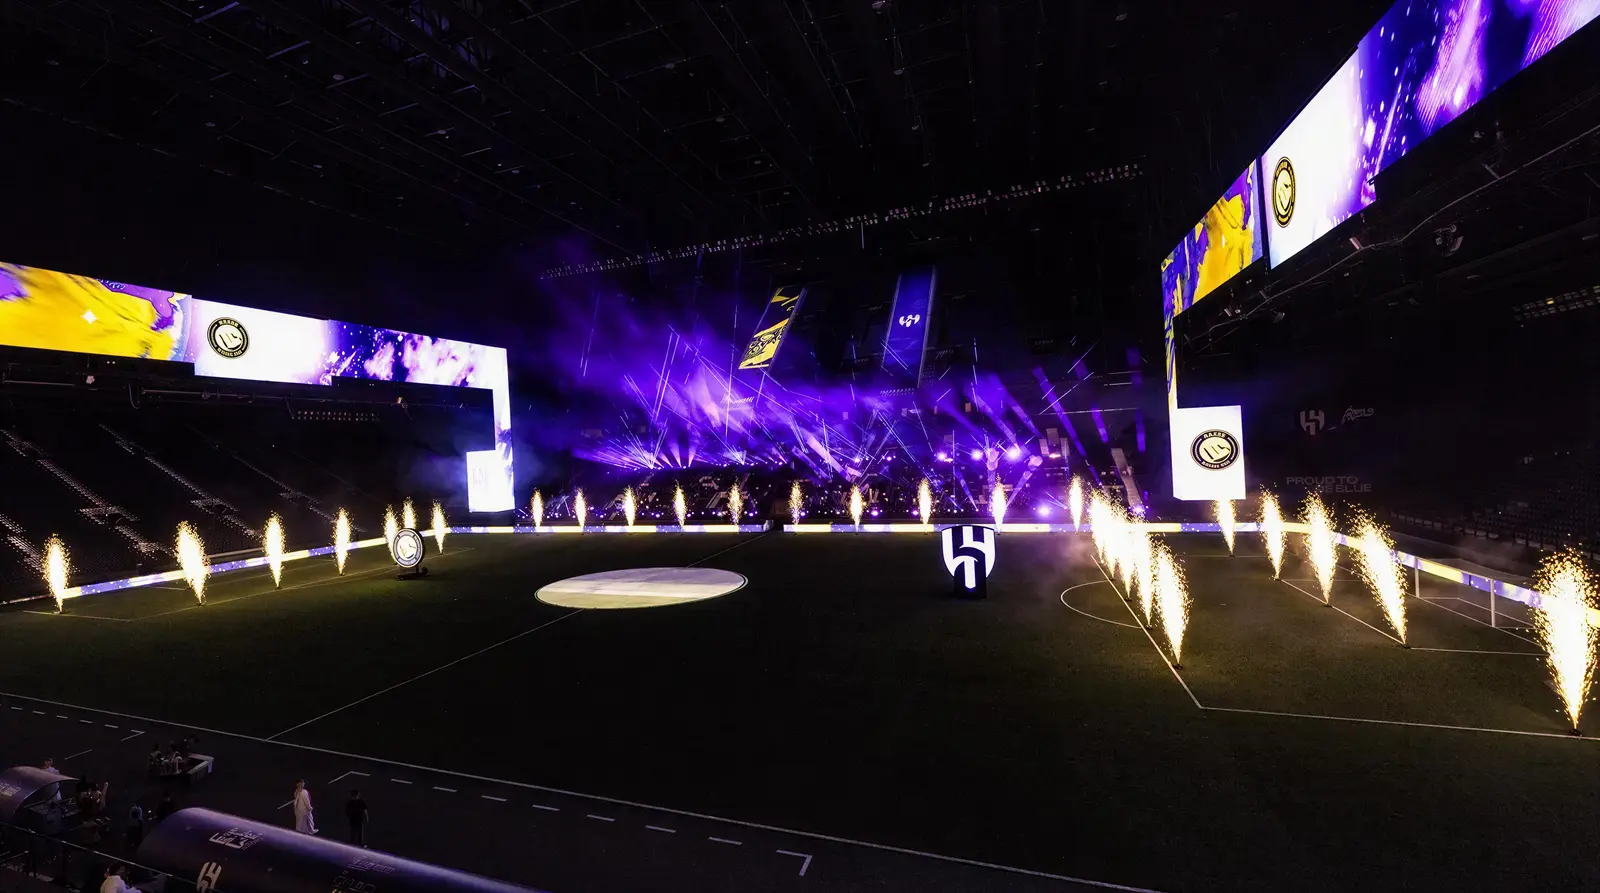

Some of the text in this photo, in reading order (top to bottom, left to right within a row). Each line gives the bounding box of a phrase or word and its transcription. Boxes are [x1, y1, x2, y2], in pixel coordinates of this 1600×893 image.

[1286, 476, 1359, 486] PROUD TO
[1335, 484, 1372, 493] BLUE
